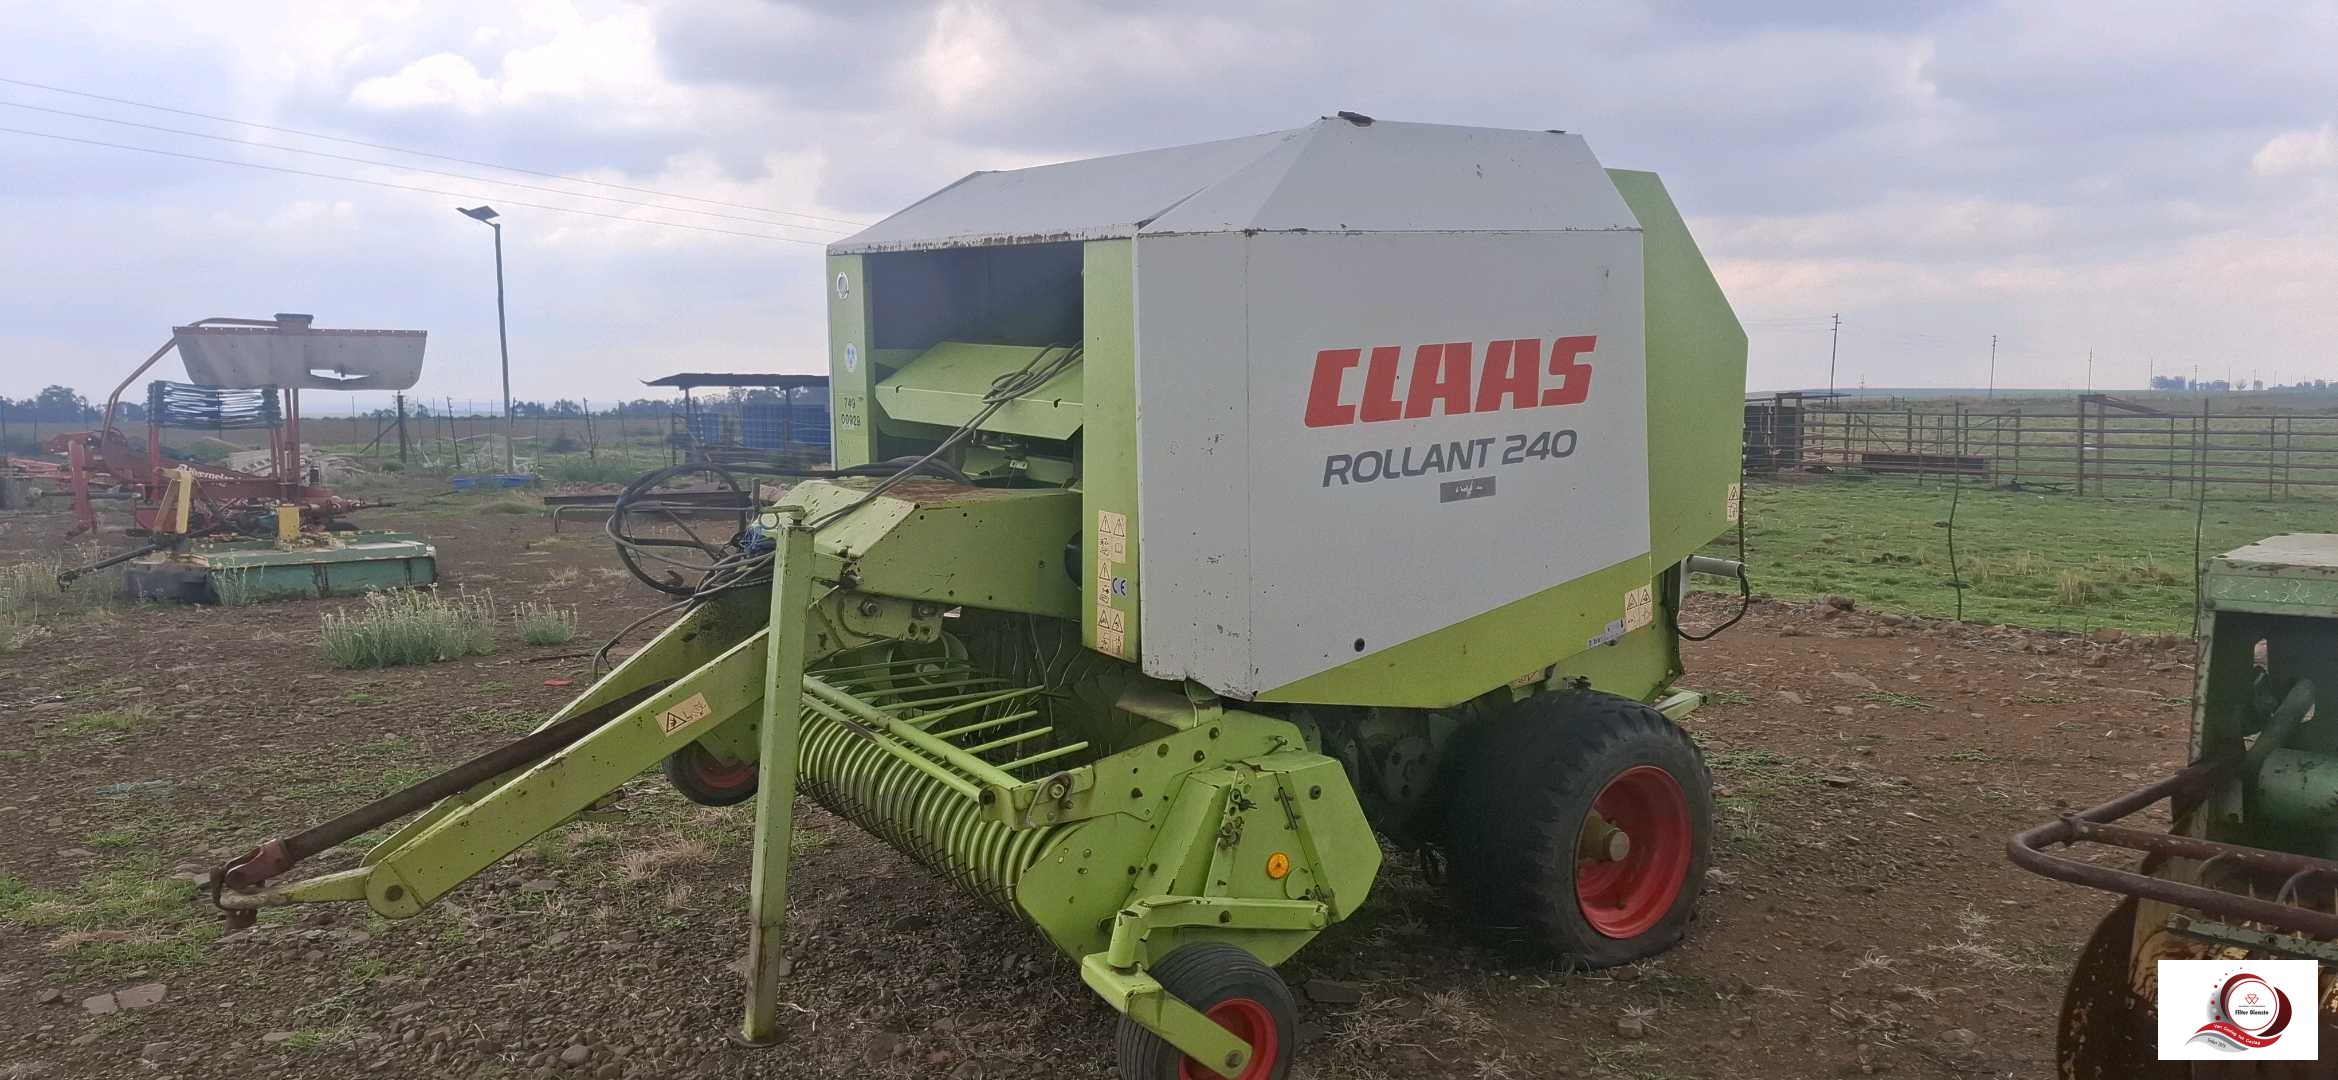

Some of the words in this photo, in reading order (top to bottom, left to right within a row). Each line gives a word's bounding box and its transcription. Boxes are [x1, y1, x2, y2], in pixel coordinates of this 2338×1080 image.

[1304, 336, 1598, 428] CLAAS
[1322, 437, 1496, 487] ROLLANT
[1501, 429, 1578, 465] 240
